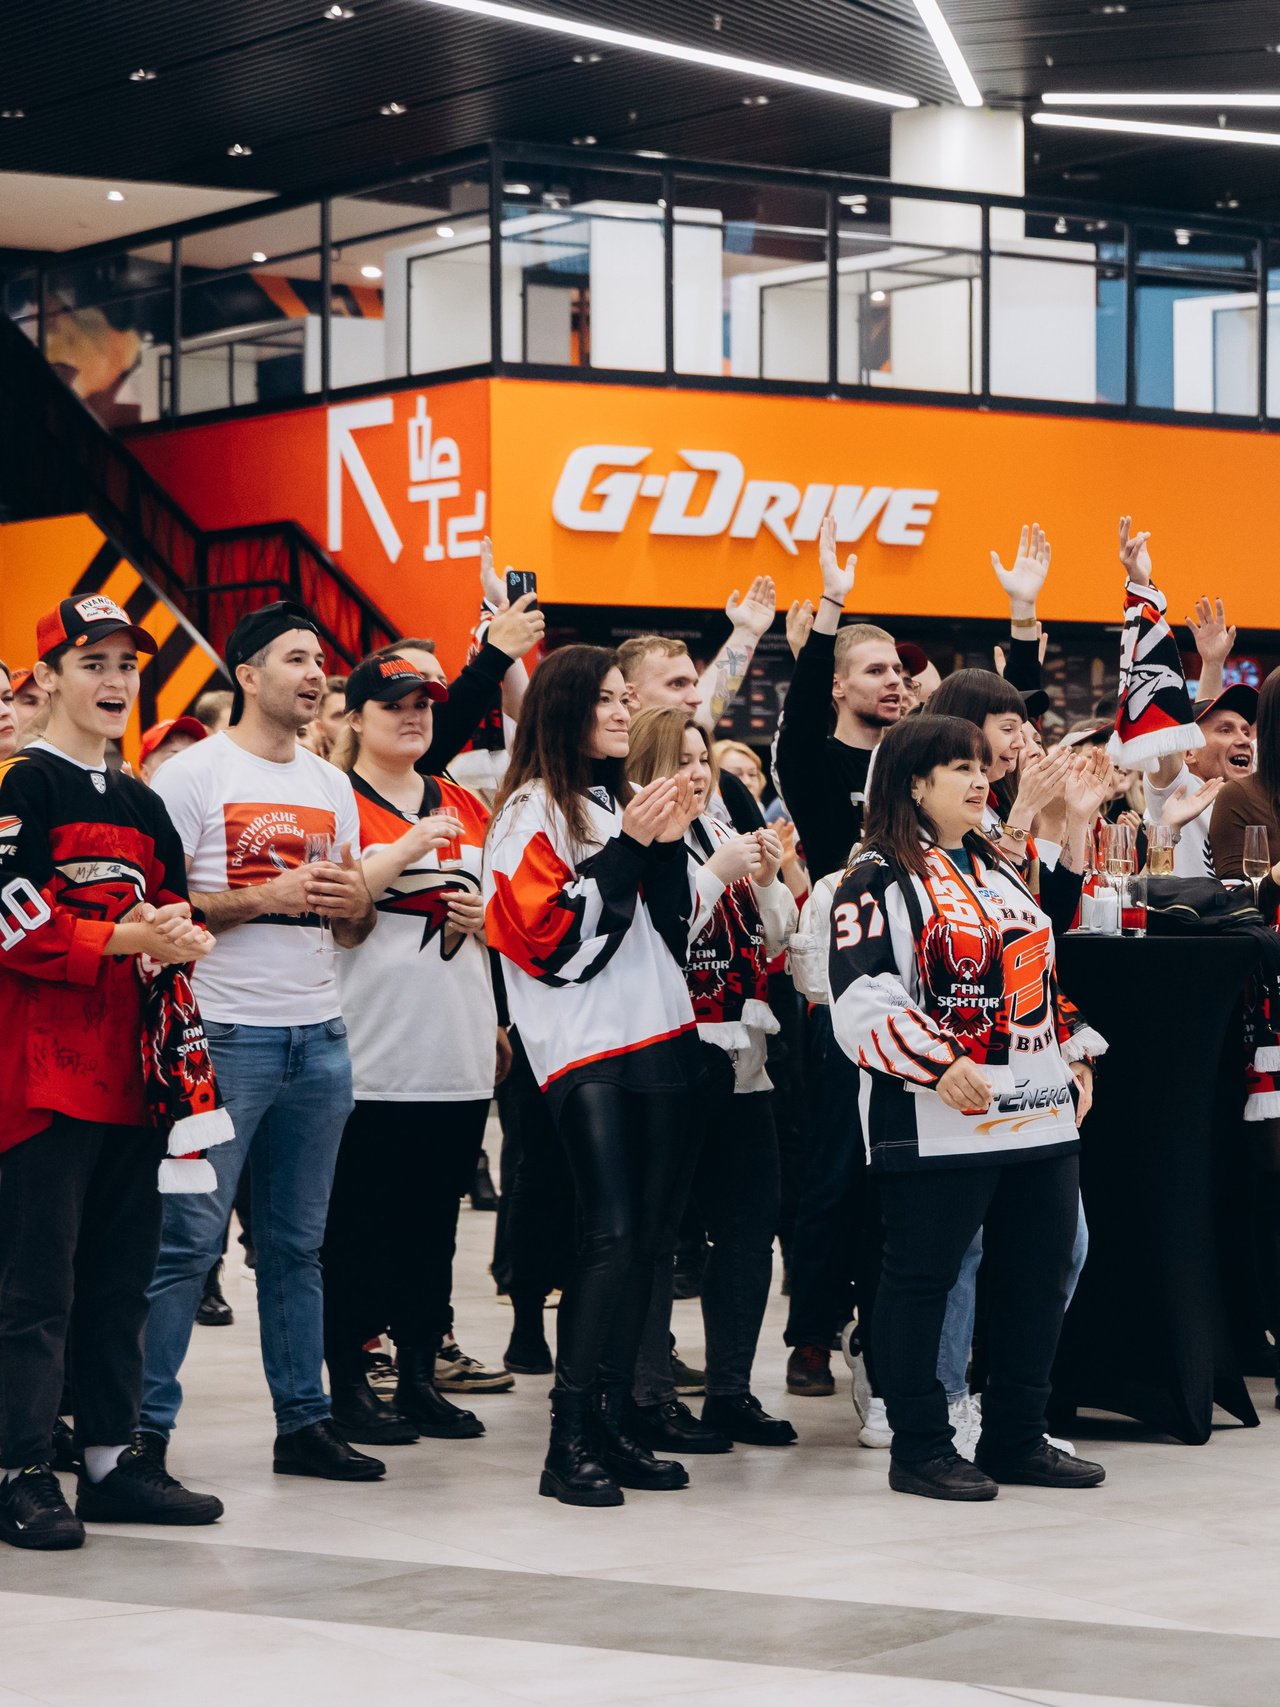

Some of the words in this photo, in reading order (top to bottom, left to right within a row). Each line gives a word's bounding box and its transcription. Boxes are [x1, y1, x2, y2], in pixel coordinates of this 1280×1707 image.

[232, 811, 298, 867] БАЛТИЙСКИЕ
[249, 824, 305, 856] ЯСТРЕБЫ
[0, 876, 52, 953] 10
[833, 891, 886, 951] 37
[937, 995, 1001, 1009] SEKTOR
[950, 983, 985, 995] FAN
